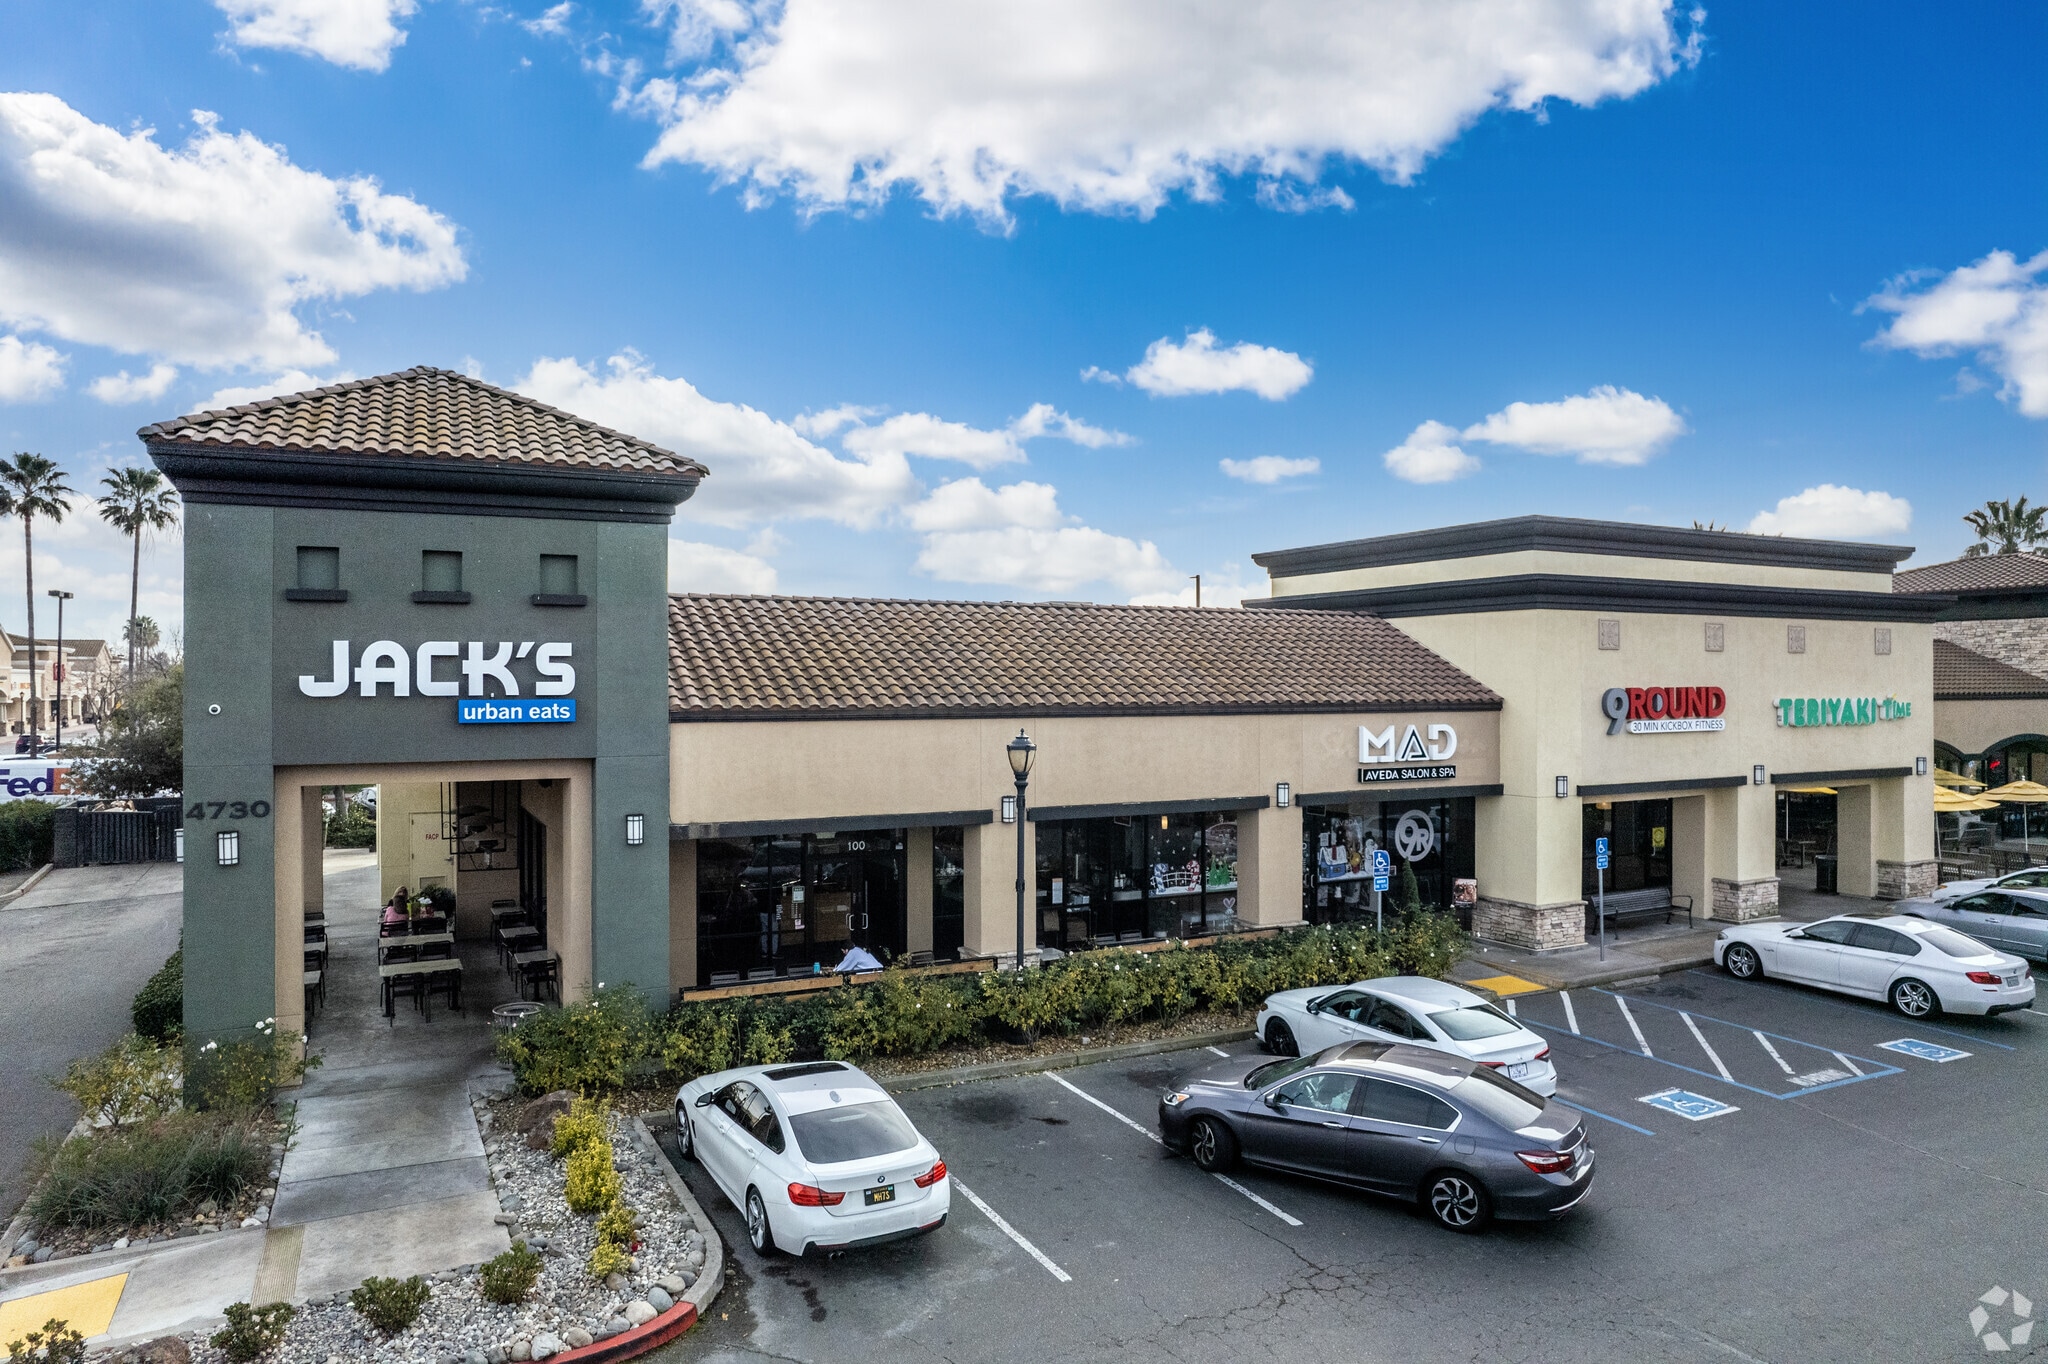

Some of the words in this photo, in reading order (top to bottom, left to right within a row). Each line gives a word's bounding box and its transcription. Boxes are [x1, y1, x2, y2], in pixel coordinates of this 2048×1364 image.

[298, 640, 576, 698] JACK'S
[463, 702, 523, 720] urban
[528, 703, 571, 719] eats
[1601, 686, 1726, 735] 9ROUND
[1776, 697, 1877, 727] TERIYAKI
[1632, 722, 1642, 732] 30
[1643, 722, 1659, 732] MIN
[1660, 721, 1693, 731] KICKBOX
[1695, 720, 1723, 730] FITNESS
[1358, 724, 1458, 763] MAD
[0, 767, 93, 797] edE
[1365, 770, 1400, 780] AVEDA
[1401, 768, 1430, 779] SALON
[1430, 768, 1437, 777] &
[1438, 767, 1455, 777] SPA
[185, 800, 271, 820] 4730
[847, 840, 866, 851] 100
